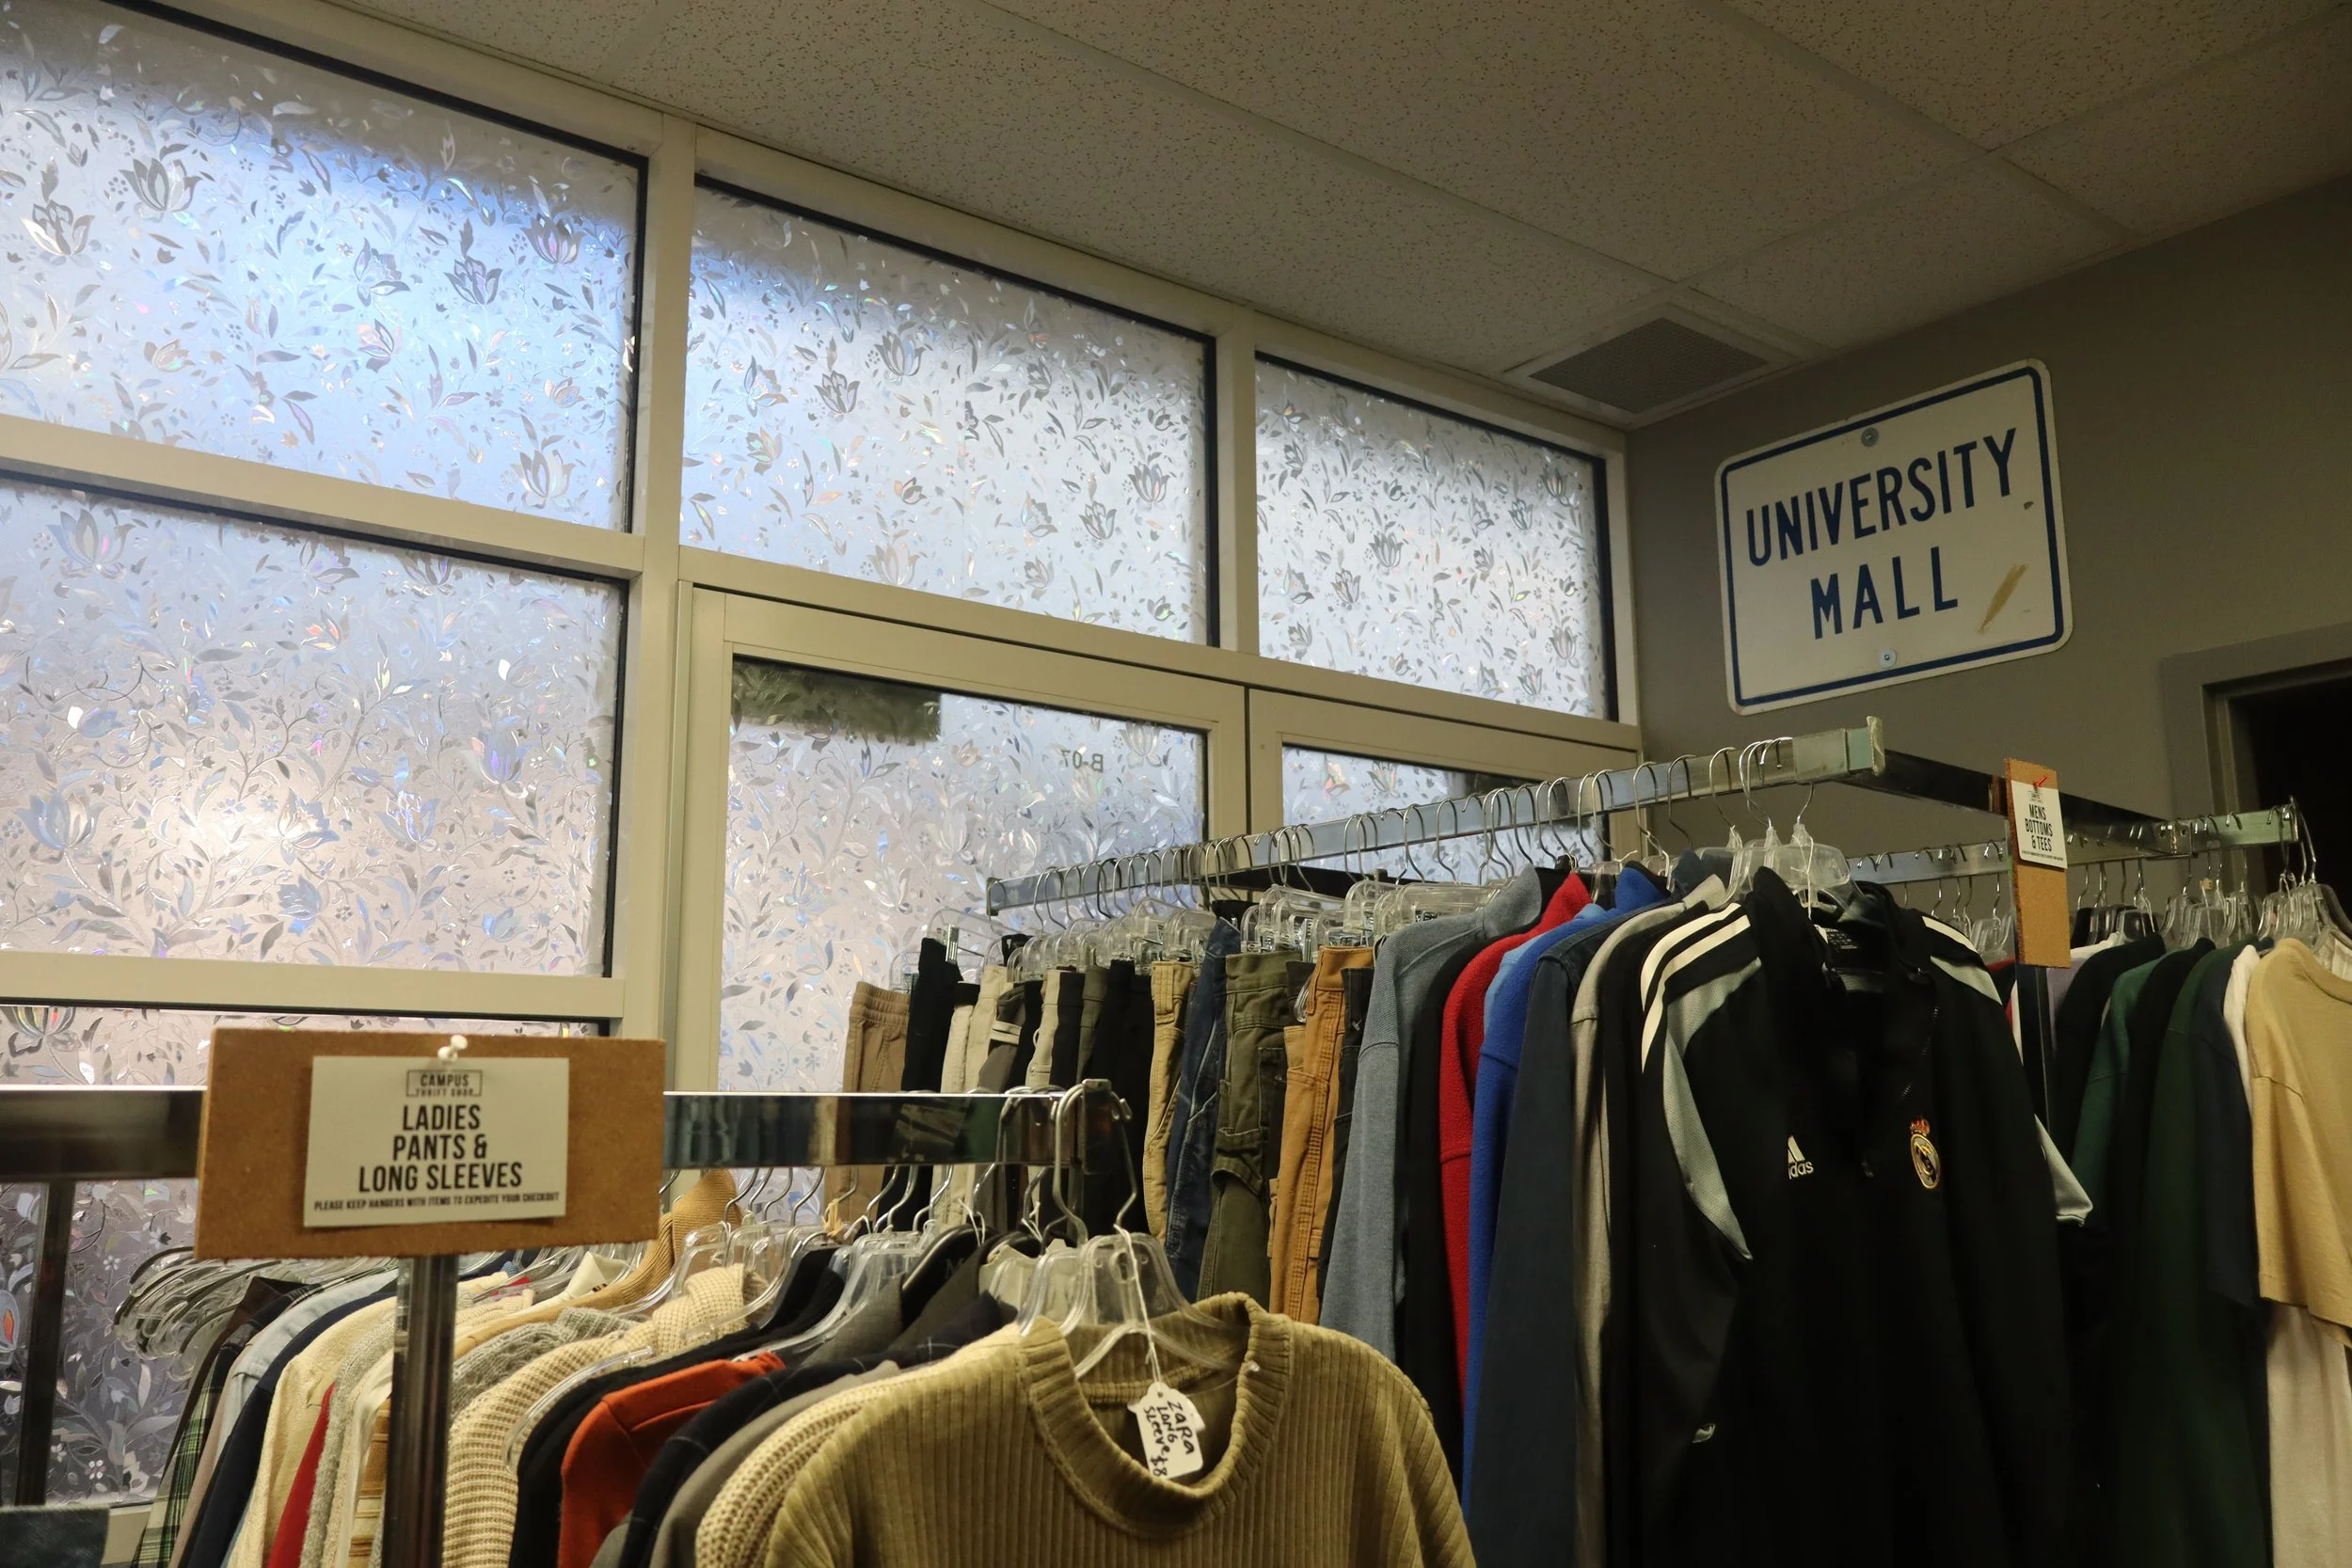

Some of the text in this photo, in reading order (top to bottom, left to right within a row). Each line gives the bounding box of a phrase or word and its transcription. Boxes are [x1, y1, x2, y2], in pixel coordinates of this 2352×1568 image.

[1746, 427, 2016, 566] UNIVERSITY
[1810, 546, 1958, 640] MALL
[2028, 804, 2046, 820] MENS
[2025, 818, 2053, 836] BOTTOMS
[2031, 835, 2052, 851] & TEES
[421, 1073, 469, 1086] CAMPUS
[403, 1104, 481, 1131] LADIES
[392, 1133, 487, 1161] PANTS &
[358, 1162, 522, 1193] LONG SLEEVES
[314, 1200, 343, 1212] PLEASE
[346, 1199, 366, 1210] KEEP
[453, 1196, 462, 1205] TO
[522, 1192, 559, 1203] CHECKOUT
